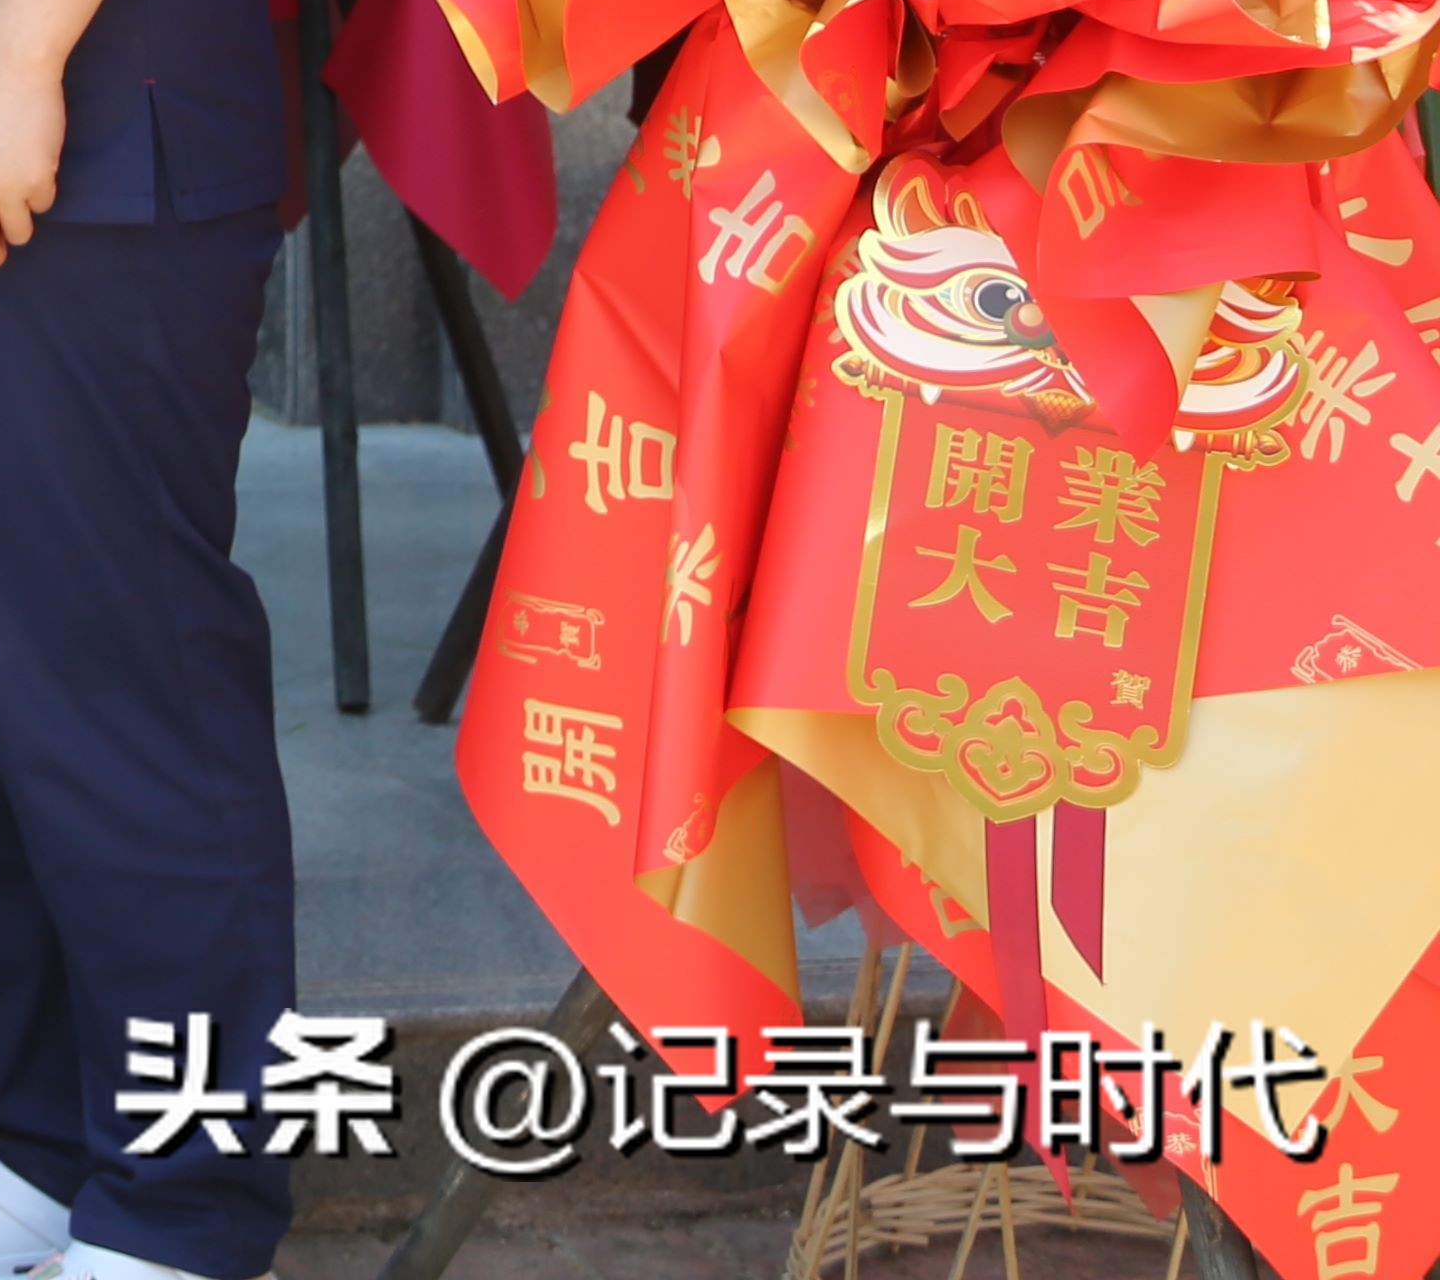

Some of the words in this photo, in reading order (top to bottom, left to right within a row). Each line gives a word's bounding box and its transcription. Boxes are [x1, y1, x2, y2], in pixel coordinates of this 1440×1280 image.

[568, 389, 678, 516] 吉
[906, 523, 1152, 649] 大吉
[521, 697, 624, 828] 開
